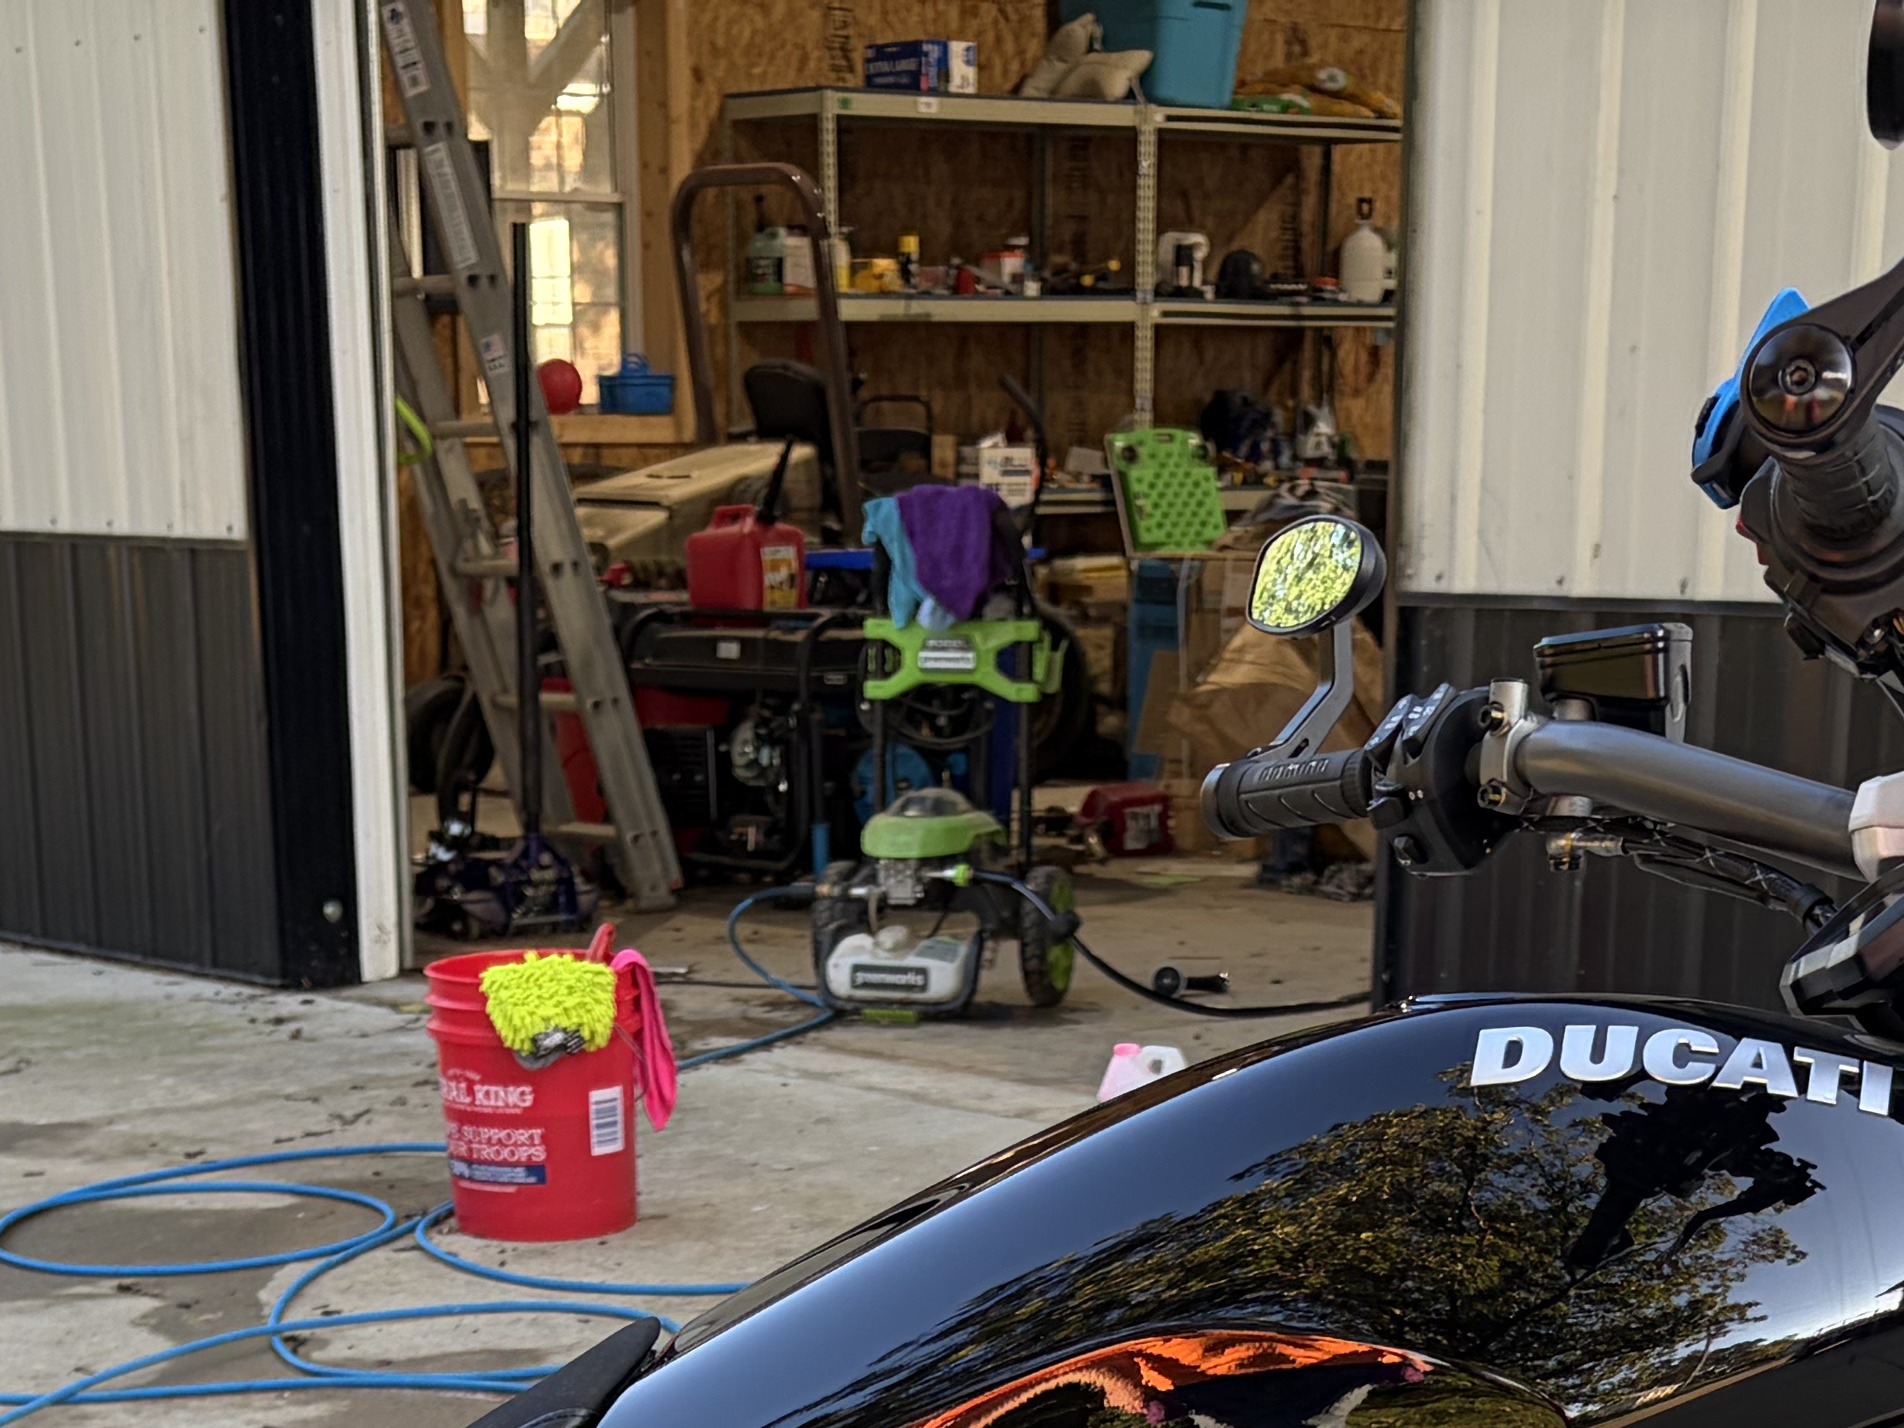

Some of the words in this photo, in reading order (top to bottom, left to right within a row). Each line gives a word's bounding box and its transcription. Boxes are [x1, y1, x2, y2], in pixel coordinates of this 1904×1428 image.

[1471, 1024, 1894, 1117] DUCATI
[473, 1084, 535, 1108] KING
[461, 1125, 545, 1145] SUPPORT
[471, 1145, 547, 1162] TROOPS
